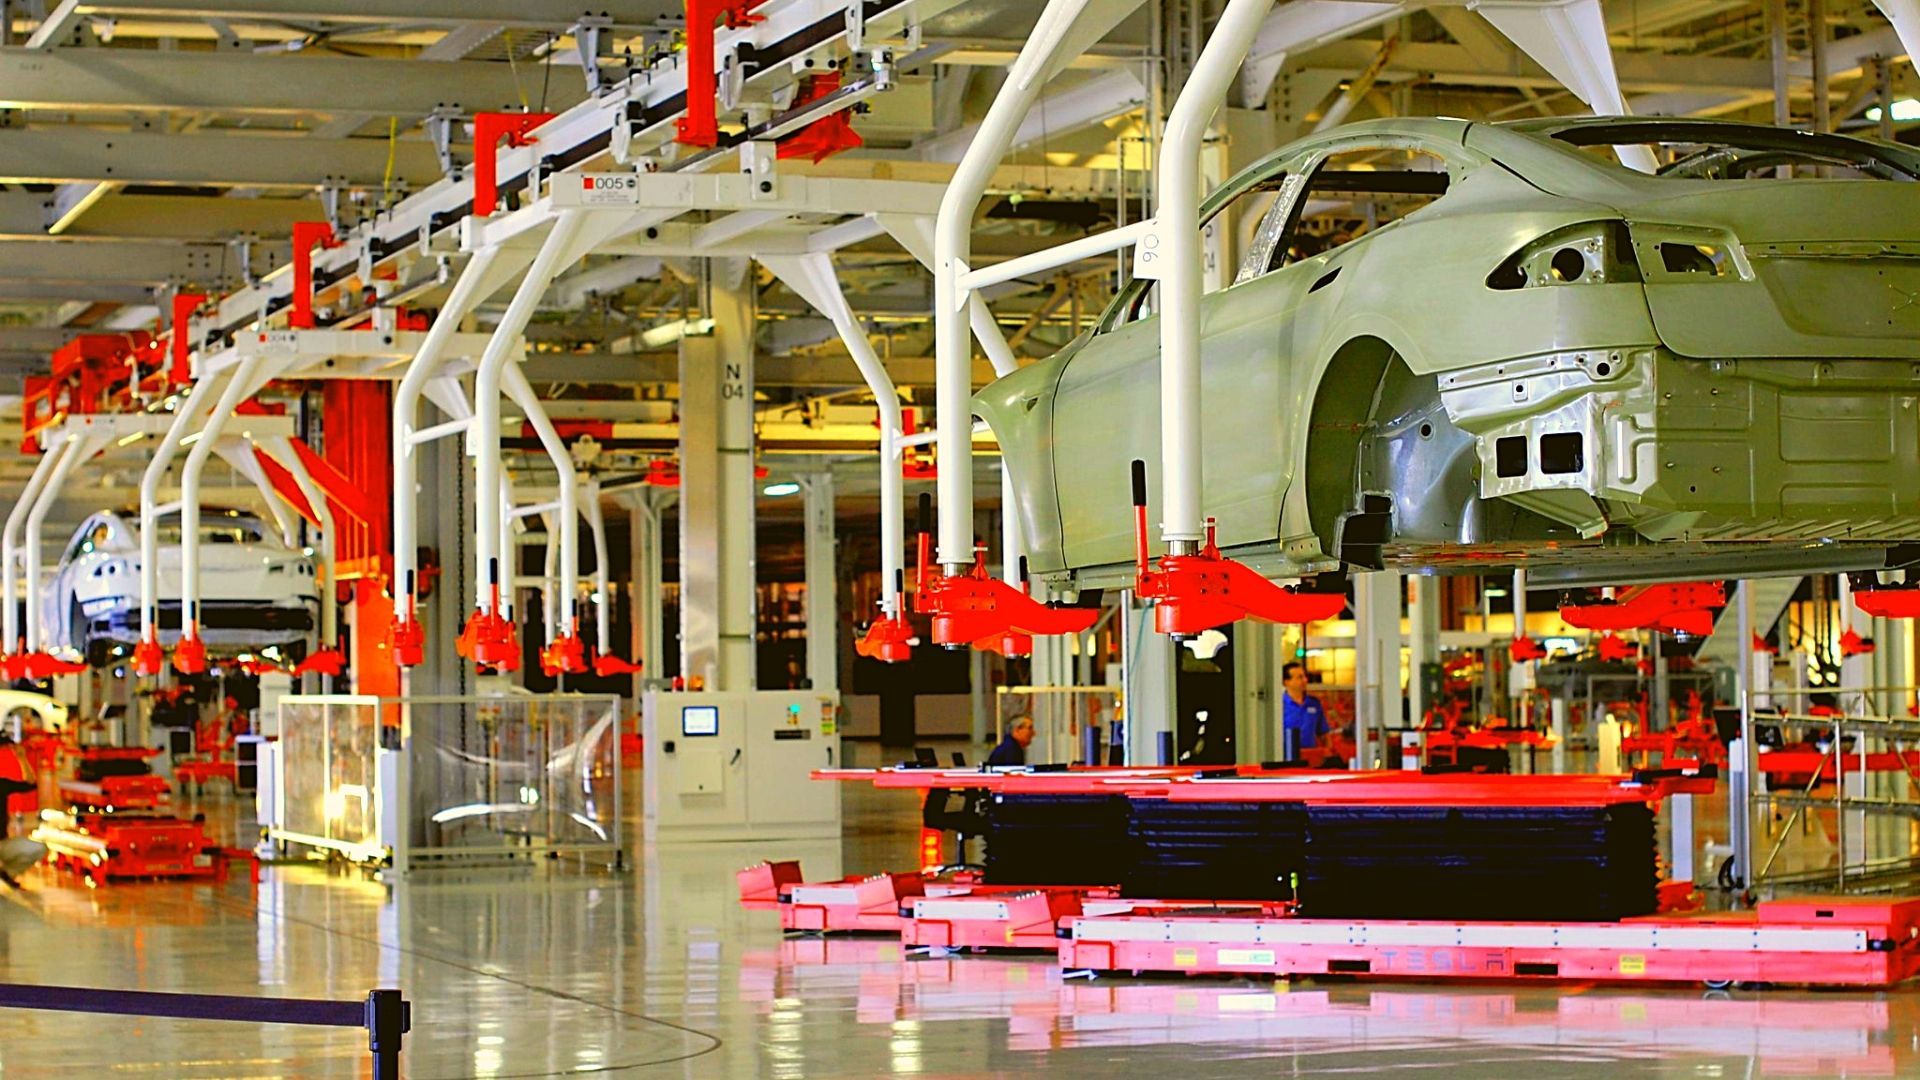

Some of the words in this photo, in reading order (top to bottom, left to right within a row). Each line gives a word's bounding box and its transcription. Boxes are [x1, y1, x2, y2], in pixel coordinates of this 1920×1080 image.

[596, 177, 624, 190] 005
[727, 364, 740, 379] N
[722, 383, 743, 400] 04
[1380, 951, 1504, 971] TESLA
